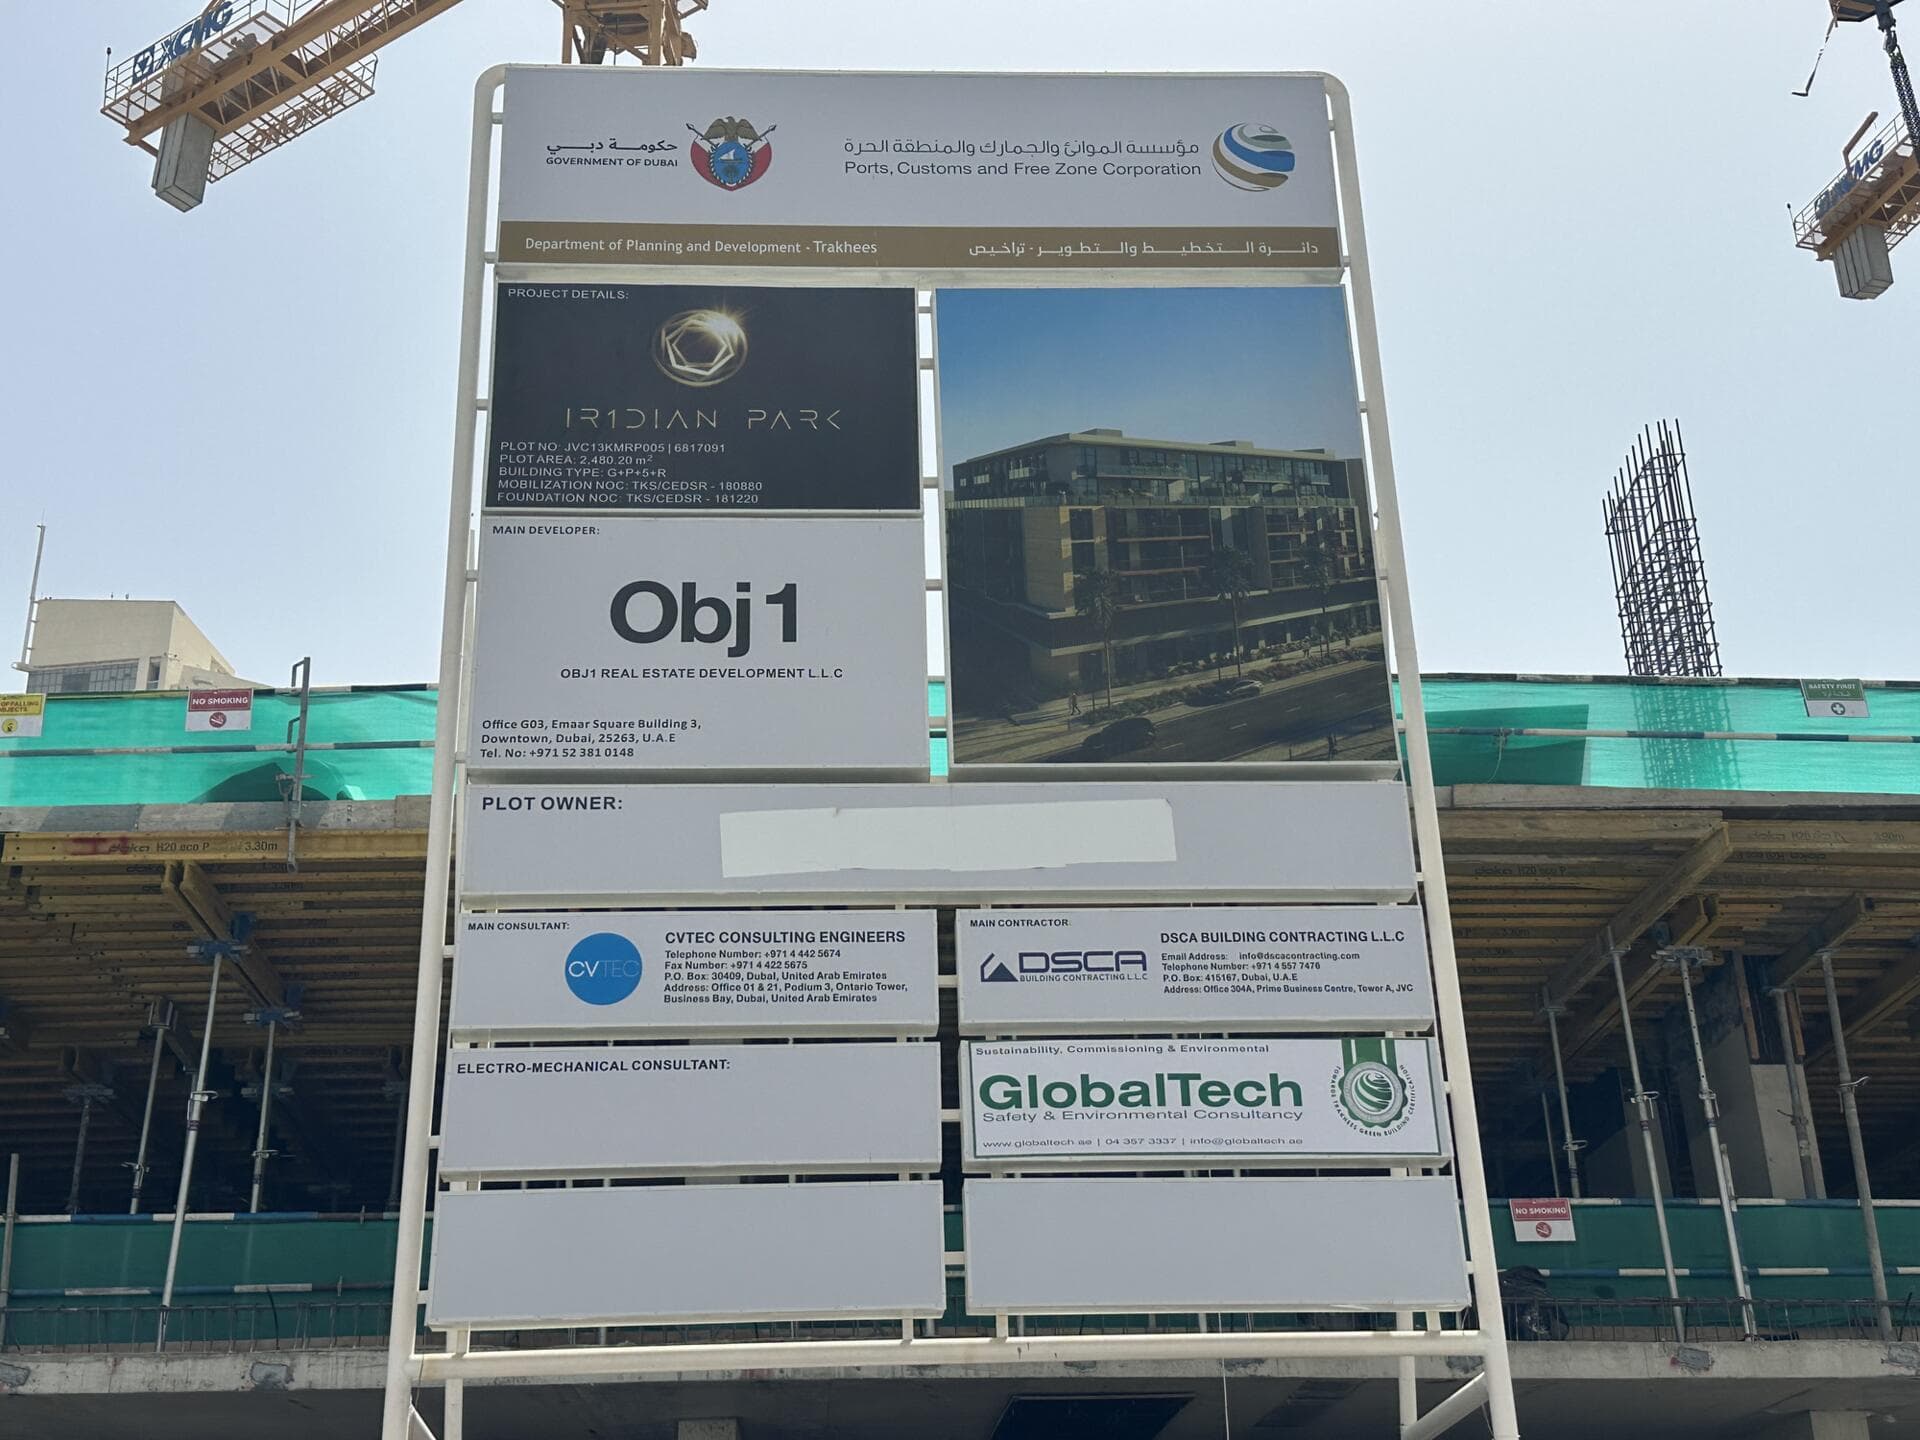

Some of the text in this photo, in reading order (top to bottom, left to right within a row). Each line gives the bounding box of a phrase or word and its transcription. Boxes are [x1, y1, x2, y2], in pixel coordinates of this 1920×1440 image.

[547, 138, 677, 155] حكومة دبي
[845, 138, 1198, 157] مؤسسة الموانئ والجمارك والمنطقة الحرة
[545, 156, 678, 167] GOVERNMENT OF DUBAI
[845, 162, 1200, 178] Ports, Customs and Free Zone Corporation
[526, 238, 877, 254] Department of Planning and Development Trakhees
[969, 241, 1318, 256] دائرة التخطيط والتطوير تراخيص
[507, 288, 629, 300] PROJECT DETAILS:
[748, 410, 840, 429] PARK
[500, 441, 725, 454] PLOT JVC13KMRP005 6817091
[499, 454, 534, 465] PLOT
[536, 454, 576, 465] AREA:
[499, 466, 666, 478] BUILDING TYPE: G+P+5+R
[498, 480, 763, 491] MOBILIZATION TKS/CEDSR 180880
[498, 492, 759, 504] FOUNDATION TKS/CEDSR 181220
[492, 525, 600, 535] MAIN DEVELOPER:
[560, 668, 805, 679] OBJ1 REAL ESTATE DEVELOPMENT
[192, 696, 249, 705] NO SMOKING
[481, 719, 687, 730] Office G03, Emaar Square Building
[481, 733, 676, 745] Downtown, Dubai, 25263, U.A.E
[480, 747, 635, 759] Tel. No: +971 52 381 0148
[482, 796, 622, 810] PLOT OWNER:
[156, 841, 178, 852] H20
[467, 921, 570, 931] MAIN CONSULTANT:
[969, 919, 996, 928] MAIN
[666, 931, 905, 944] CVTEC CONSULTING ENGINEERS
[1161, 931, 1368, 943] DSCA BUILDING CONTRACTING
[664, 948, 841, 960] Telephone Number: 442 5674
[1161, 952, 1360, 962] Email info@dscacontracting.com
[664, 960, 809, 970] Fax Number: 422 5675
[1018, 951, 1148, 973] DSCA
[1161, 961, 1297, 972] Telephone Number: 557
[568, 960, 640, 977] CVTEC
[664, 970, 887, 982] P.O. 30409, Dubai, United Arab Emirates
[1019, 972, 1126, 983] BUILDING CONTRACTING
[1162, 972, 1299, 983] P.O. 415167, Dubai, U.A.E
[711, 981, 907, 993] Office 01 21, Podium Ontario Tower,
[1203, 983, 1414, 993] Office Prime Business Tower JVC
[663, 993, 878, 1004] Business Bay, Dubai, United Arab Emirates
[1066, 1044, 1163, 1055] Commissioning
[1180, 1044, 1269, 1053] Environmental
[458, 1059, 730, 1074] ELECTRO-MECHANICAL CONSULTANT:
[980, 1073, 1302, 1110] GlobalTech
[983, 1110, 1302, 1123] Safety Environmental Consultancy
[1515, 1206, 1568, 1215] NO SMOKING
